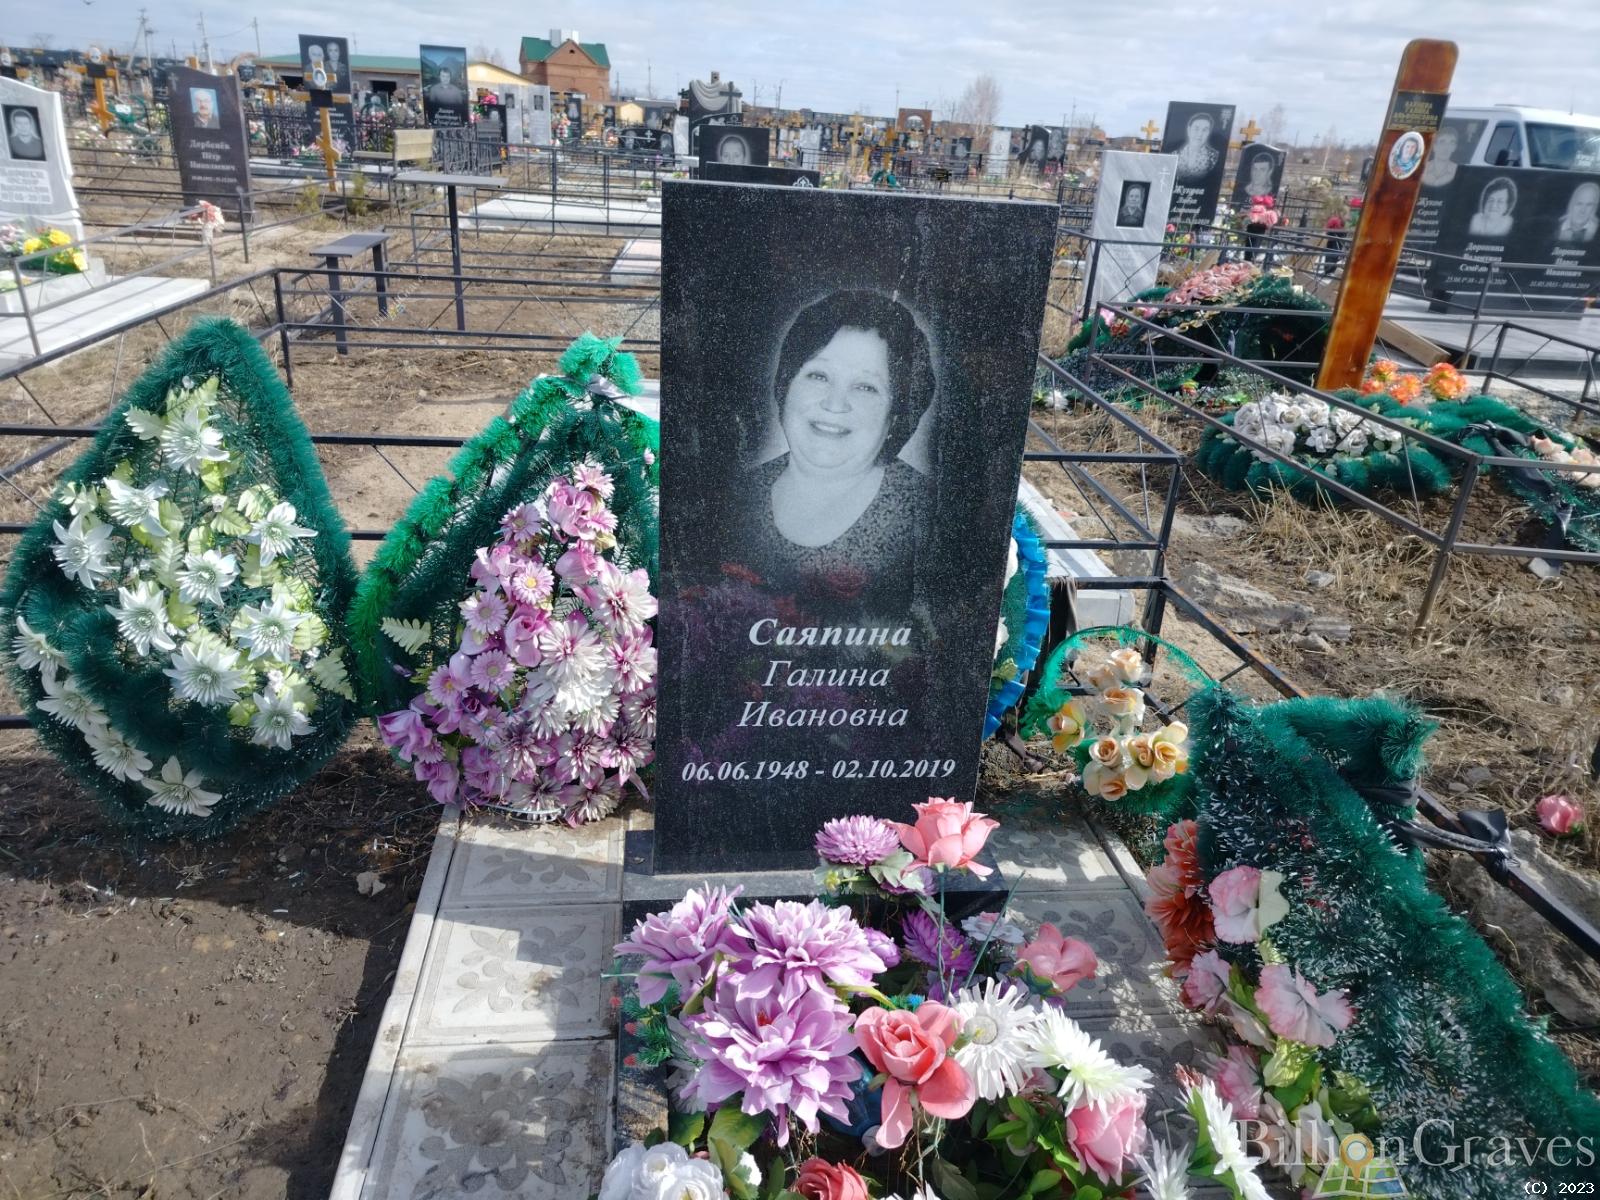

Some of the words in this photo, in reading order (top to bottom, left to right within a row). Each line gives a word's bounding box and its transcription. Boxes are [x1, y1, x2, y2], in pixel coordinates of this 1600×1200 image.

[749, 618, 912, 646] Саяпина
[762, 660, 890, 687] Галина
[736, 701, 909, 728] Ивановна
[682, 760, 809, 781] 06.06.1948
[832, 759, 956, 779] 02.10.2019
